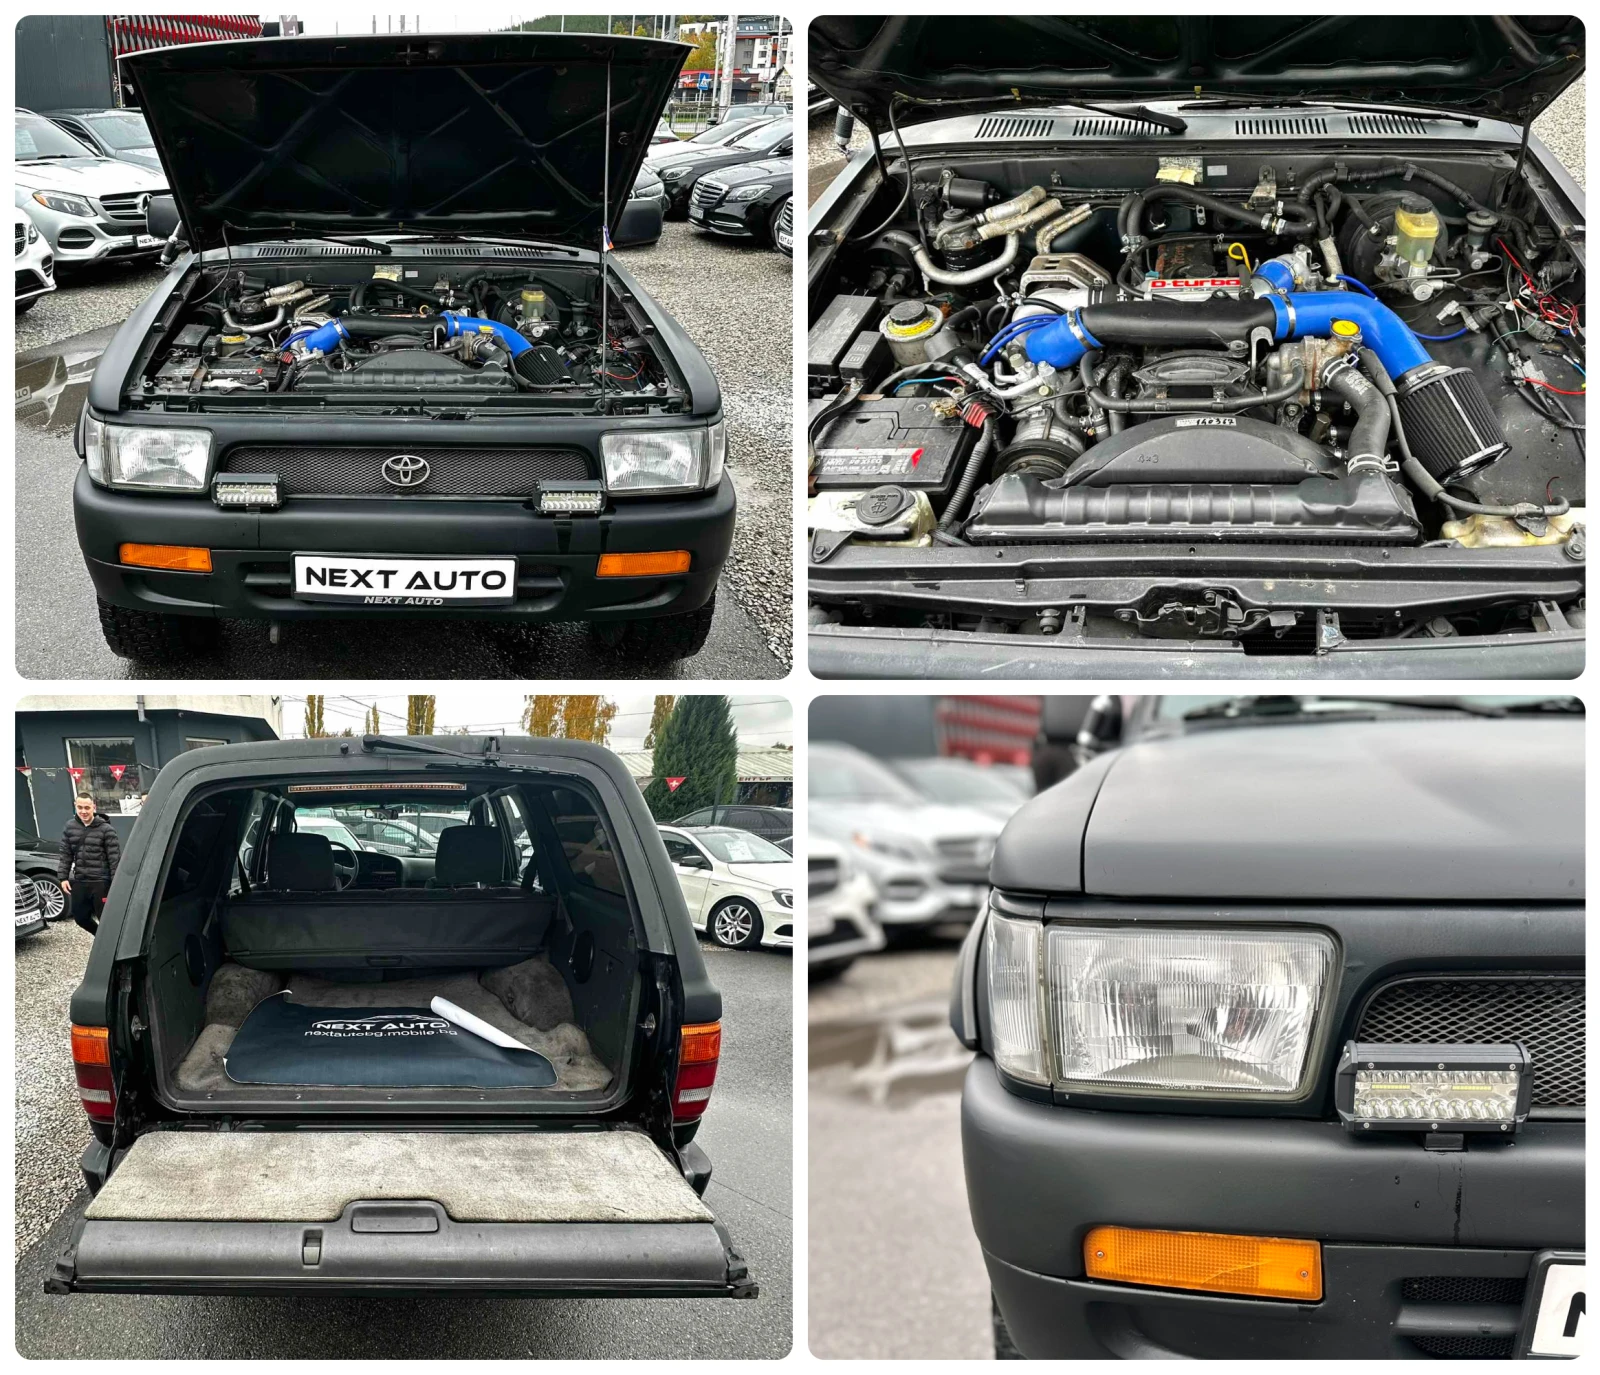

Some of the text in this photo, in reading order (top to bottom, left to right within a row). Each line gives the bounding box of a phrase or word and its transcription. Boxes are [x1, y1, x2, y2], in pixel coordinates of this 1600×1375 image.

[306, 566, 507, 590] NEXT AUTO
[364, 596, 443, 606] NEXT AUTO
[381, 1022, 447, 1030] AUTO
[304, 1028, 458, 1038] nextautobg.mobile.bg
